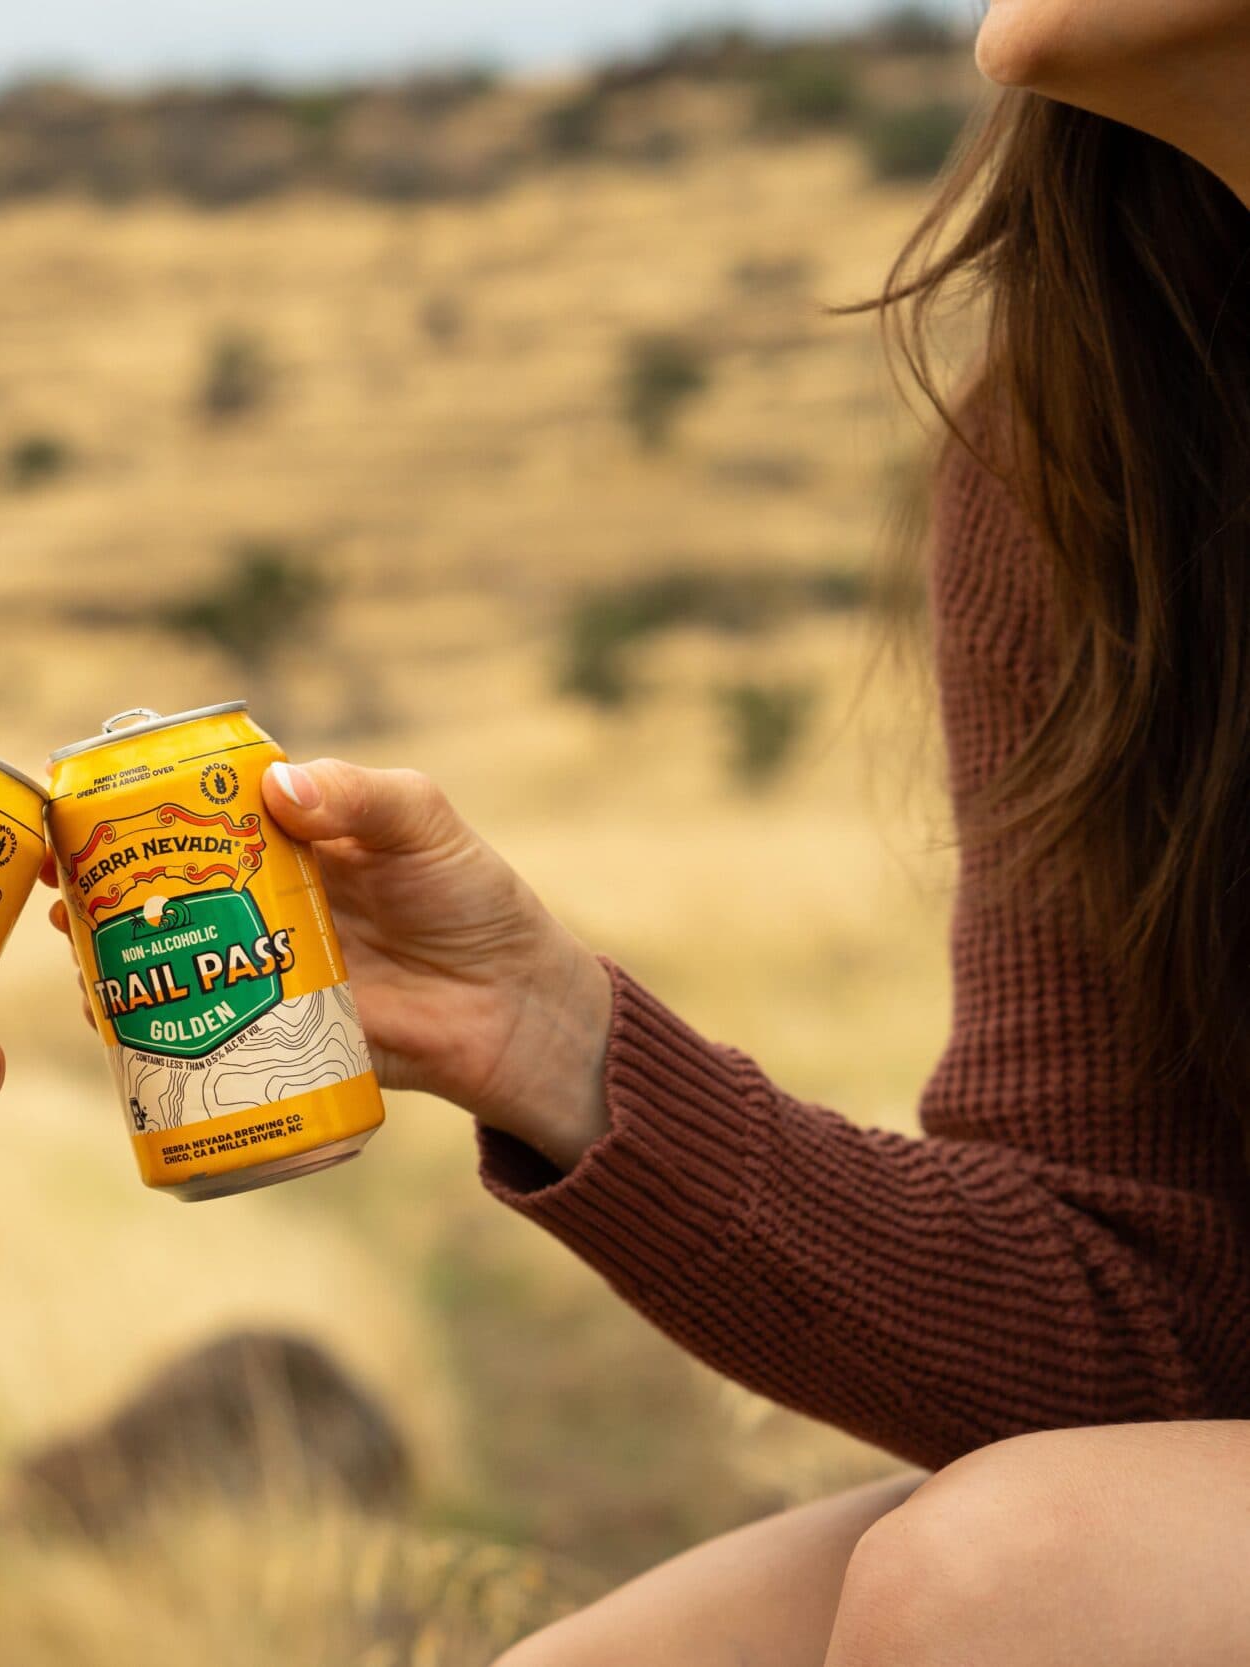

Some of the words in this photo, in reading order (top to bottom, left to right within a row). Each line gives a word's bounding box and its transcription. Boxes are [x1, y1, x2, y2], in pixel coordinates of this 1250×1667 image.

[76, 783, 111, 799] OPERATED
[112, 781, 118, 789] &
[119, 773, 151, 787] ARGUED
[152, 765, 175, 777] OVER
[93, 773, 117, 786] FAMILY
[119, 765, 150, 778] OWNED,
[202, 763, 238, 780] SMOOTH
[78, 846, 139, 895] SIERRA
[121, 925, 219, 963] NON-ALCOHOLIC
[93, 960, 190, 1019] TRAIL
[150, 1000, 237, 1042] GOLDEN
[135, 1052, 165, 1067] CONTAINS
[165, 1059, 184, 1070] LESS
[185, 1061, 206, 1072] THAN
[205, 1050, 225, 1068] 0.5%
[224, 1042, 239, 1056] ALC
[236, 1034, 250, 1047] BY
[247, 1023, 263, 1038] VOL
[162, 1142, 191, 1156] SIERRA
[192, 1135, 234, 1149] NEVADA
[234, 1119, 284, 1139] BREWING
[285, 1114, 304, 1124] CO.
[164, 1153, 193, 1165] CHICO,
[194, 1148, 208, 1159] CA
[208, 1147, 216, 1155] &
[217, 1139, 249, 1153] MILLS
[250, 1128, 288, 1145] RIVER,
[288, 1122, 304, 1133] NC
